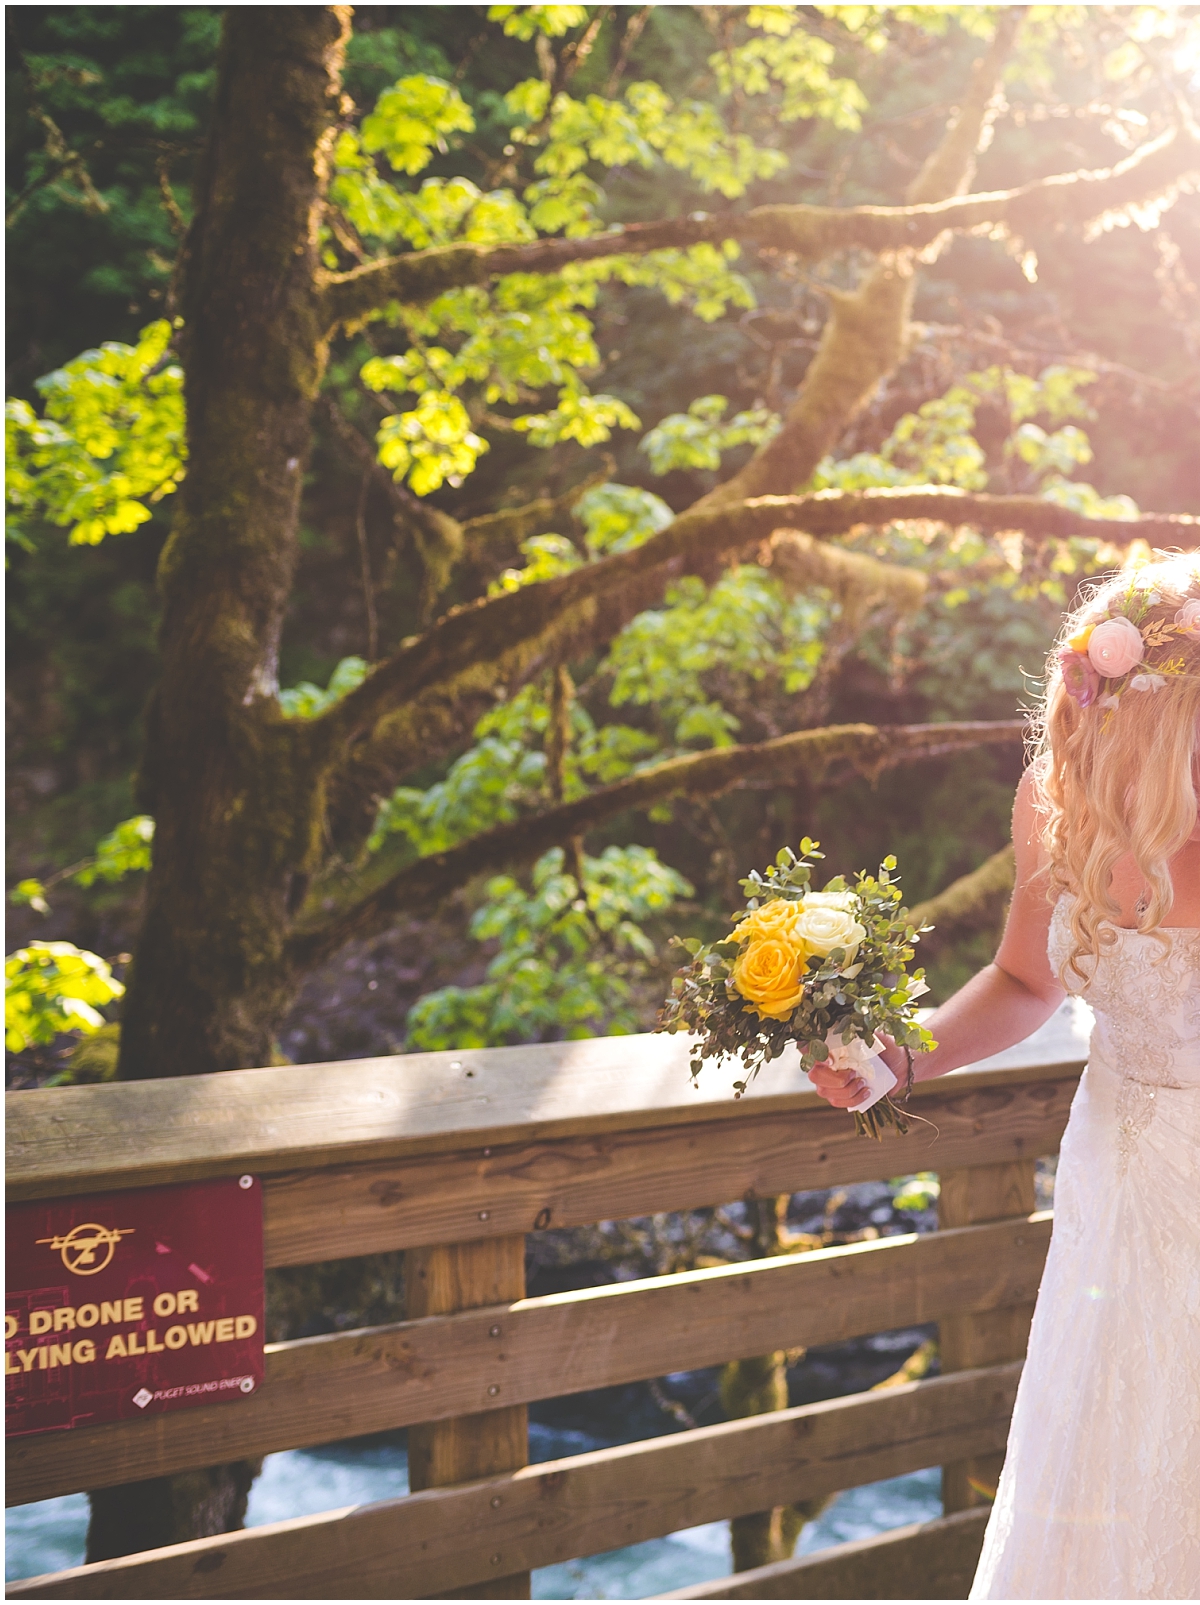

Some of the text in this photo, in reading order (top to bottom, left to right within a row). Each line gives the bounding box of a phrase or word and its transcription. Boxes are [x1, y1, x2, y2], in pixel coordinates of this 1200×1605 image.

[29, 1297, 144, 1335] DRONE
[153, 1289, 199, 1317] OR
[5, 1315, 257, 1375] LYING ALLOWED
[154, 1386, 185, 1401] PUGET
[185, 1381, 219, 1396] SOUND
